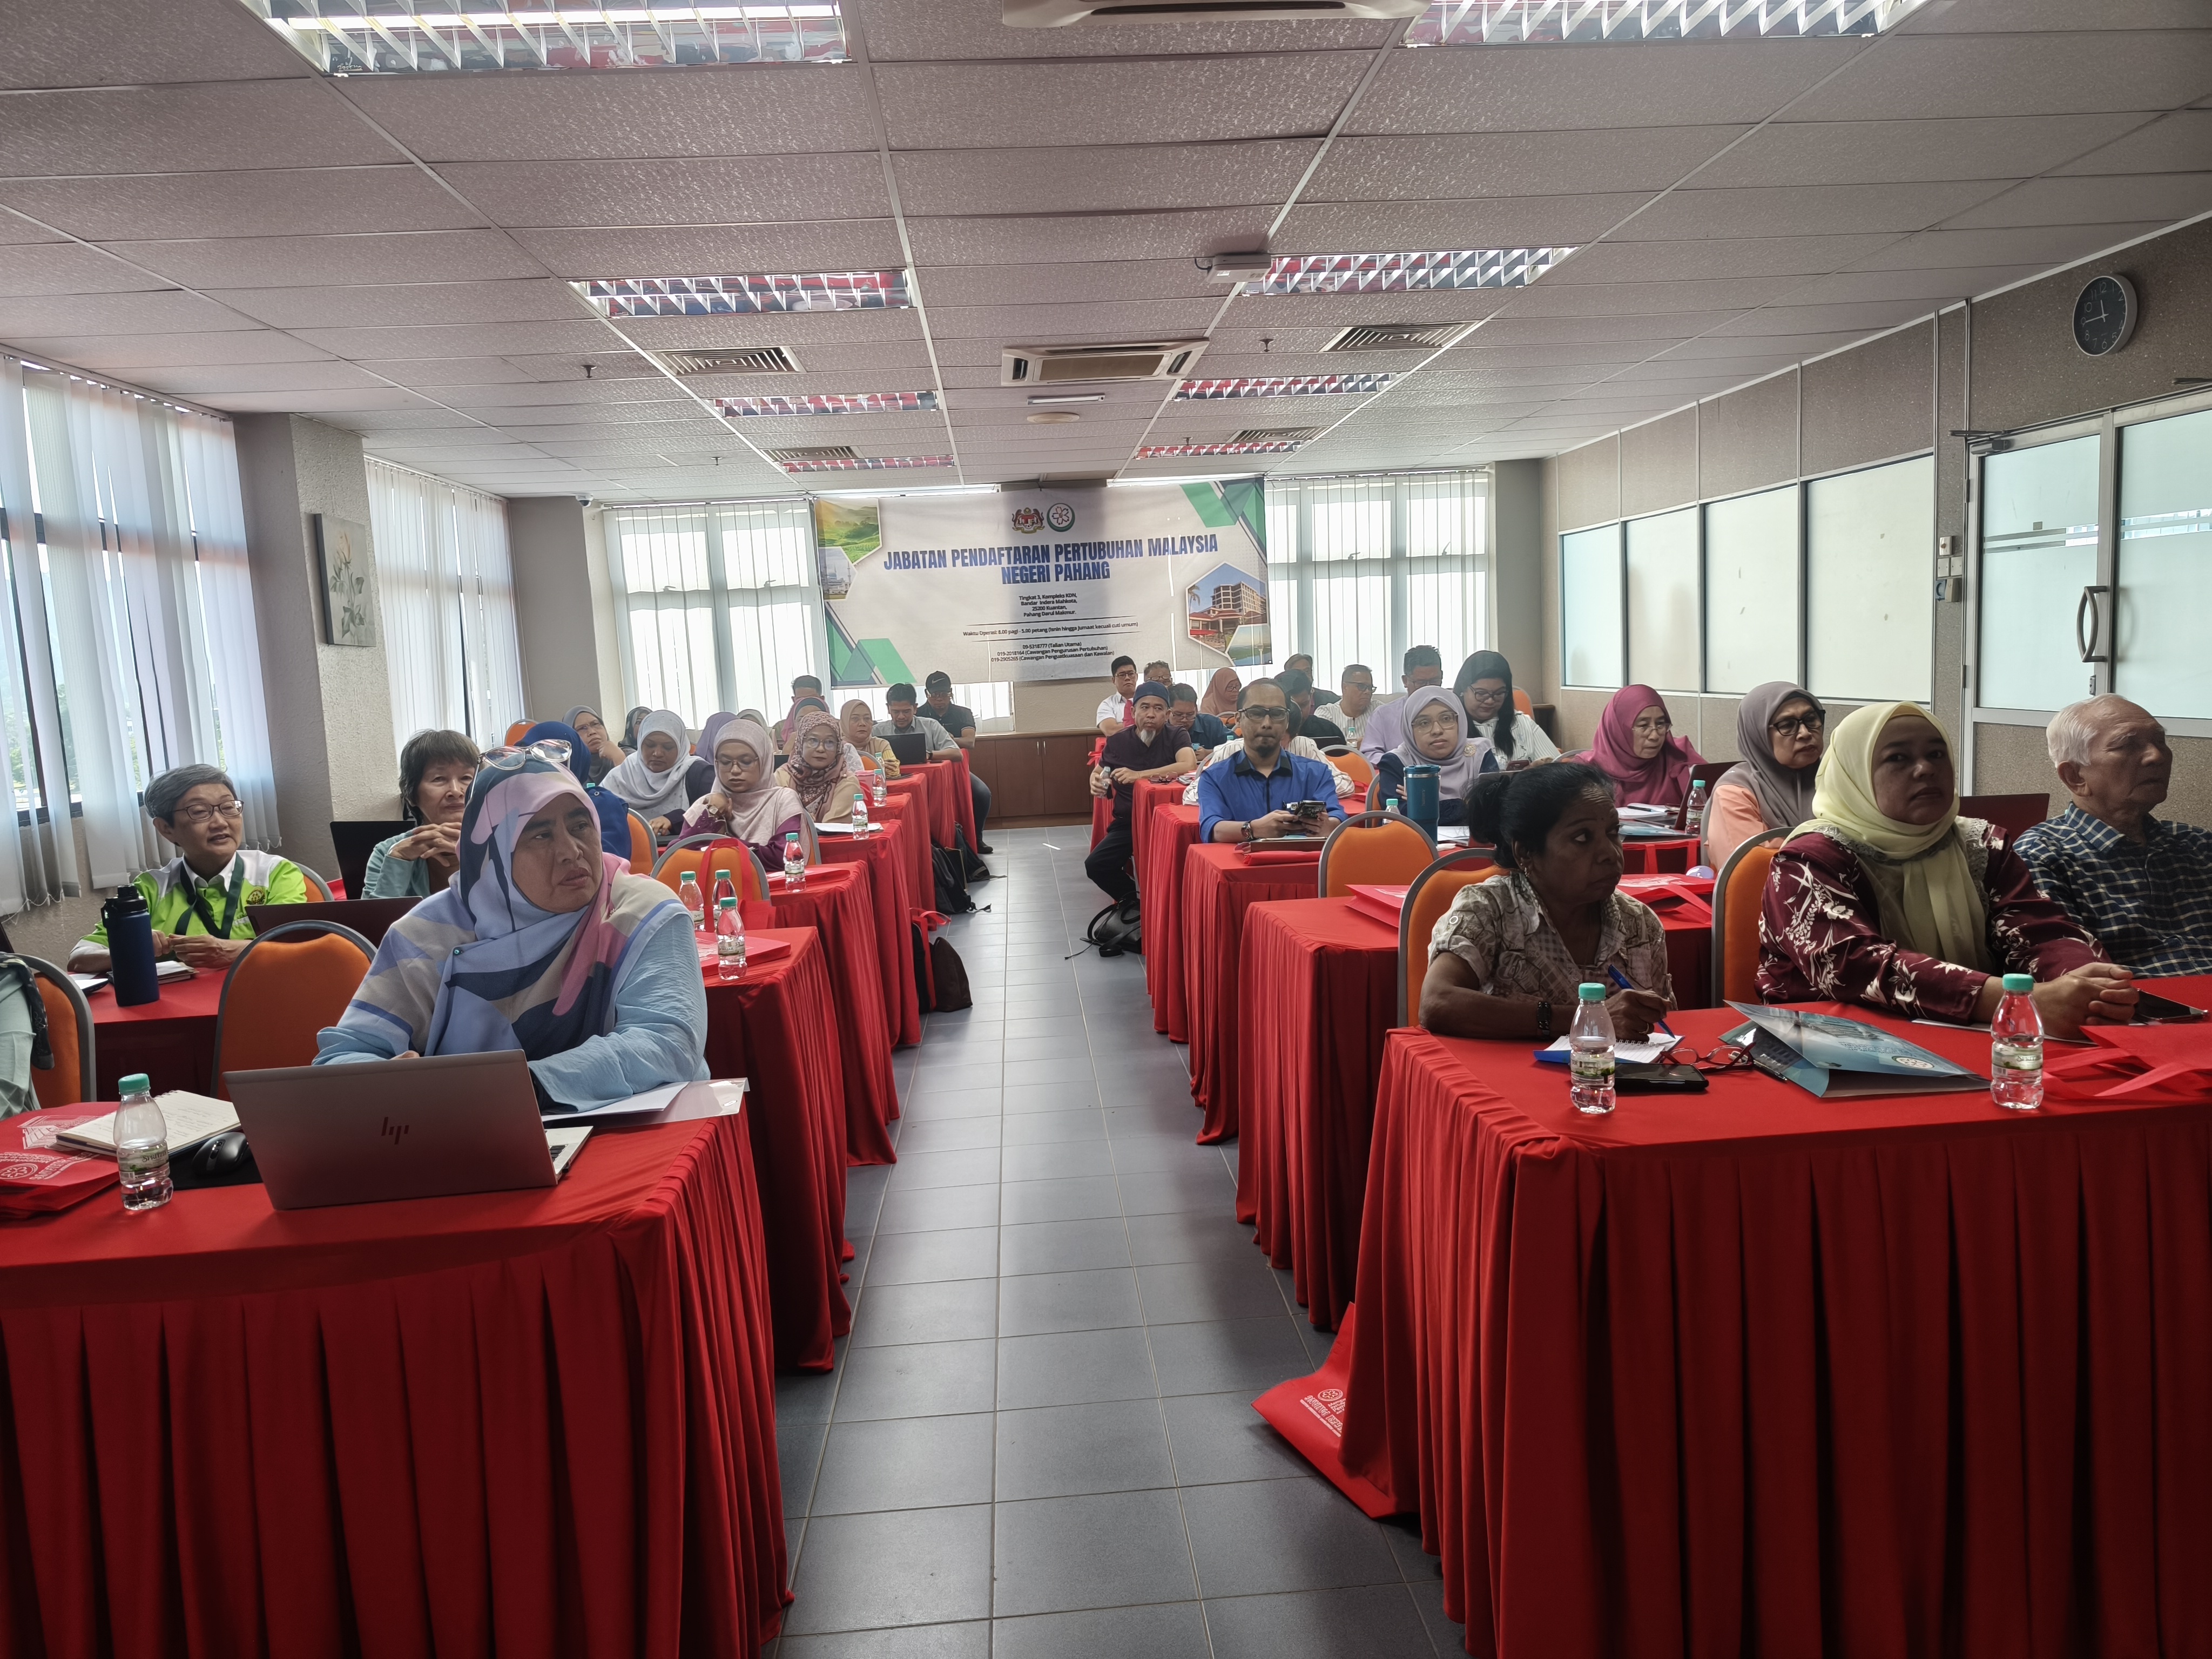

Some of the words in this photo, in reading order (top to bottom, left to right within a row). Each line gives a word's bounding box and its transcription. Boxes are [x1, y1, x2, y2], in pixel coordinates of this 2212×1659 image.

[2099, 282, 2107, 294] 12
[2090, 289, 2097, 301] 11
[2118, 290, 2124, 301] 2
[2083, 302, 2092, 313] 10
[2080, 317, 2086, 328] 9
[2085, 330, 2090, 341] 8
[2112, 332, 2117, 343] 5
[2092, 338, 2098, 349] 7
[2102, 339, 2107, 349] 6
[884, 549, 947, 570] JABATAN
[951, 544, 1050, 568] PENDAFTARAN
[1054, 539, 1143, 562] PERTUBUHAN
[1148, 534, 1218, 557] MALAYSIA
[1001, 564, 1051, 584] NEGERI
[1055, 561, 1110, 582] PAHANG
